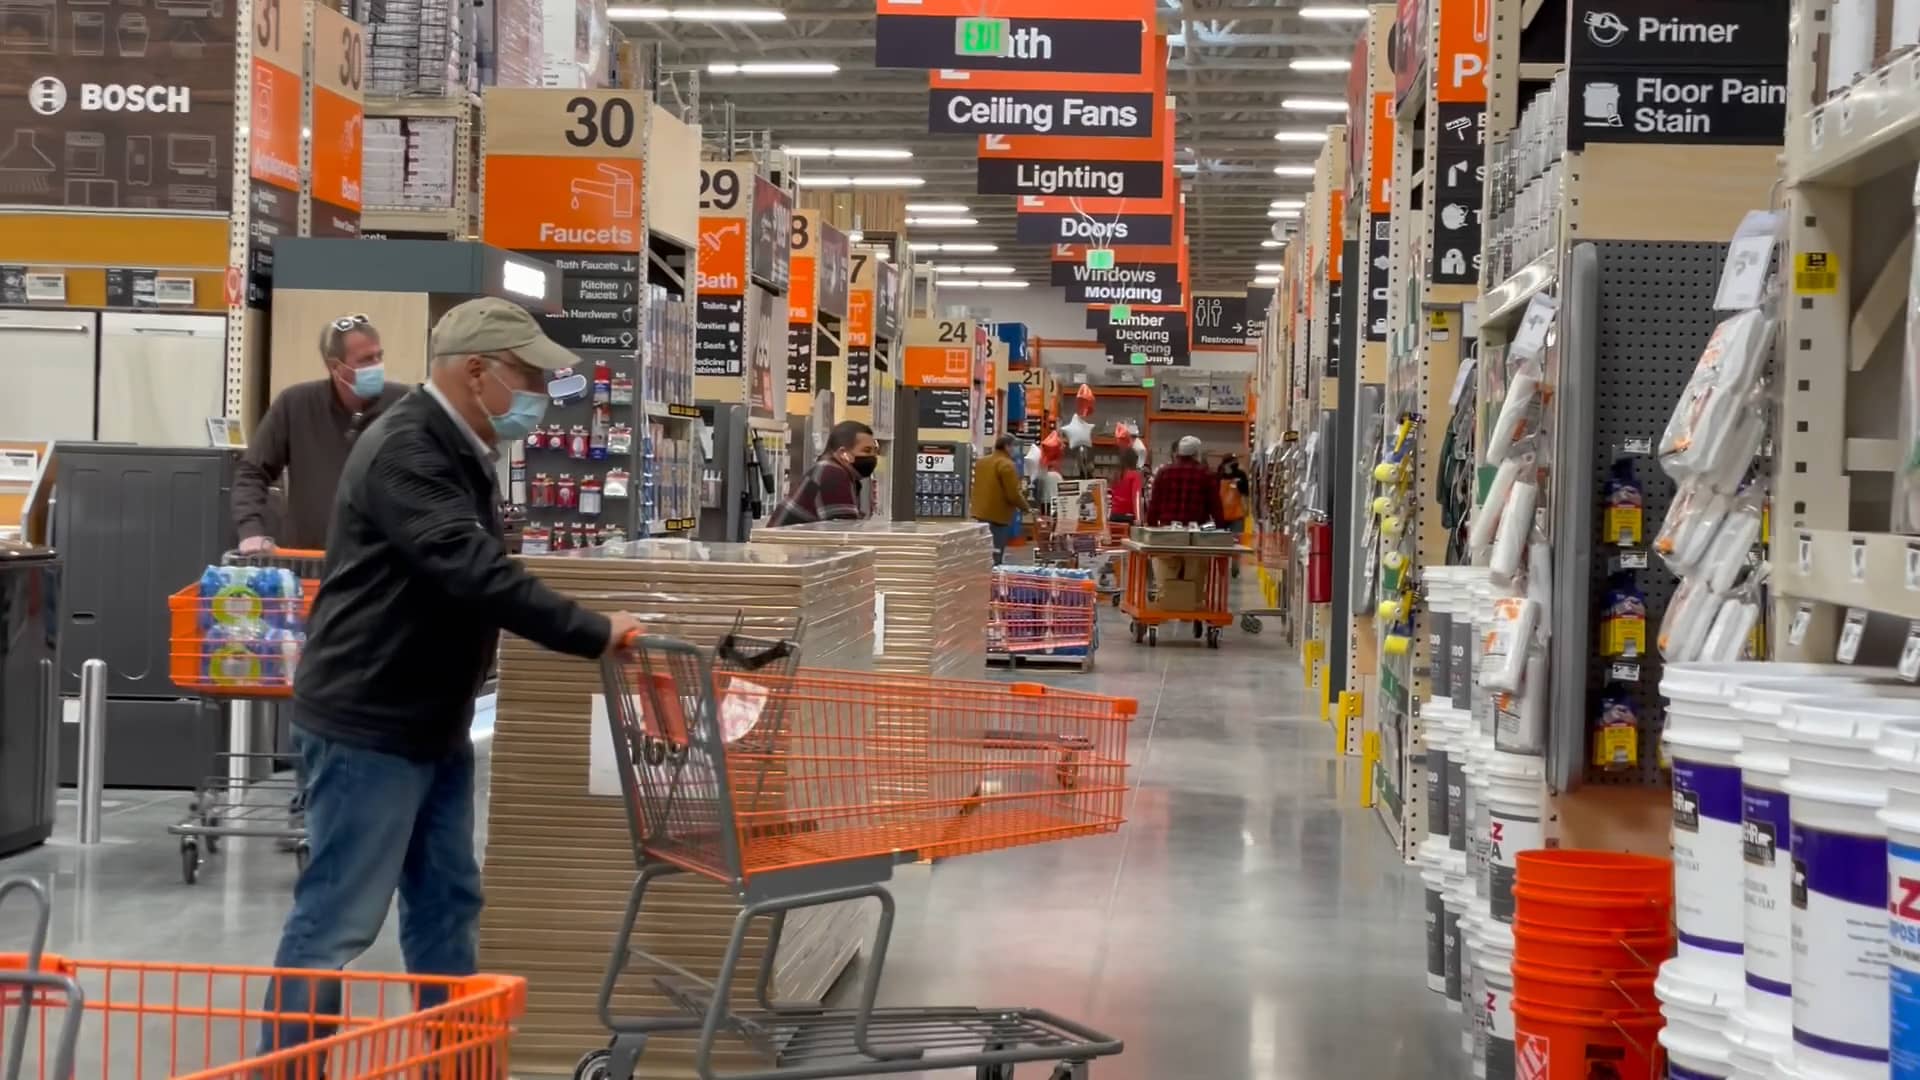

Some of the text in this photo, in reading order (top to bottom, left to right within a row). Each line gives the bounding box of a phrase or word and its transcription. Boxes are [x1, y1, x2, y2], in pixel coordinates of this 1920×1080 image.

[1638, 17, 1738, 44] Primer
[996, 27, 1052, 59] th
[339, 26, 362, 91] 30
[80, 83, 190, 113] BOSCH
[1636, 77, 1786, 104] Floor Pain
[565, 96, 634, 148] 30
[948, 95, 1138, 132] Ceiling Fans
[1634, 107, 1711, 133] Stain
[1016, 164, 1124, 195] Lighting
[539, 223, 633, 245] Faucets
[791, 215, 809, 249] 8
[1060, 217, 1128, 238] Doors
[581, 260, 619, 270] Faucets
[850, 255, 867, 283] 7
[1073, 265, 1156, 283] Windows
[581, 280, 618, 290] Kitchen
[697, 271, 738, 289] Bath
[580, 290, 618, 300] Faucets
[1085, 286, 1162, 304] Moulding
[570, 309, 618, 320] Hardware
[581, 334, 617, 344] Mirrors
[938, 321, 967, 343] 24
[1116, 329, 1169, 343] Decking
[1201, 335, 1244, 344] Restrooms
[1123, 343, 1171, 356] Fencing
[922, 375, 968, 385] Windows
[1023, 370, 1041, 385] 21
